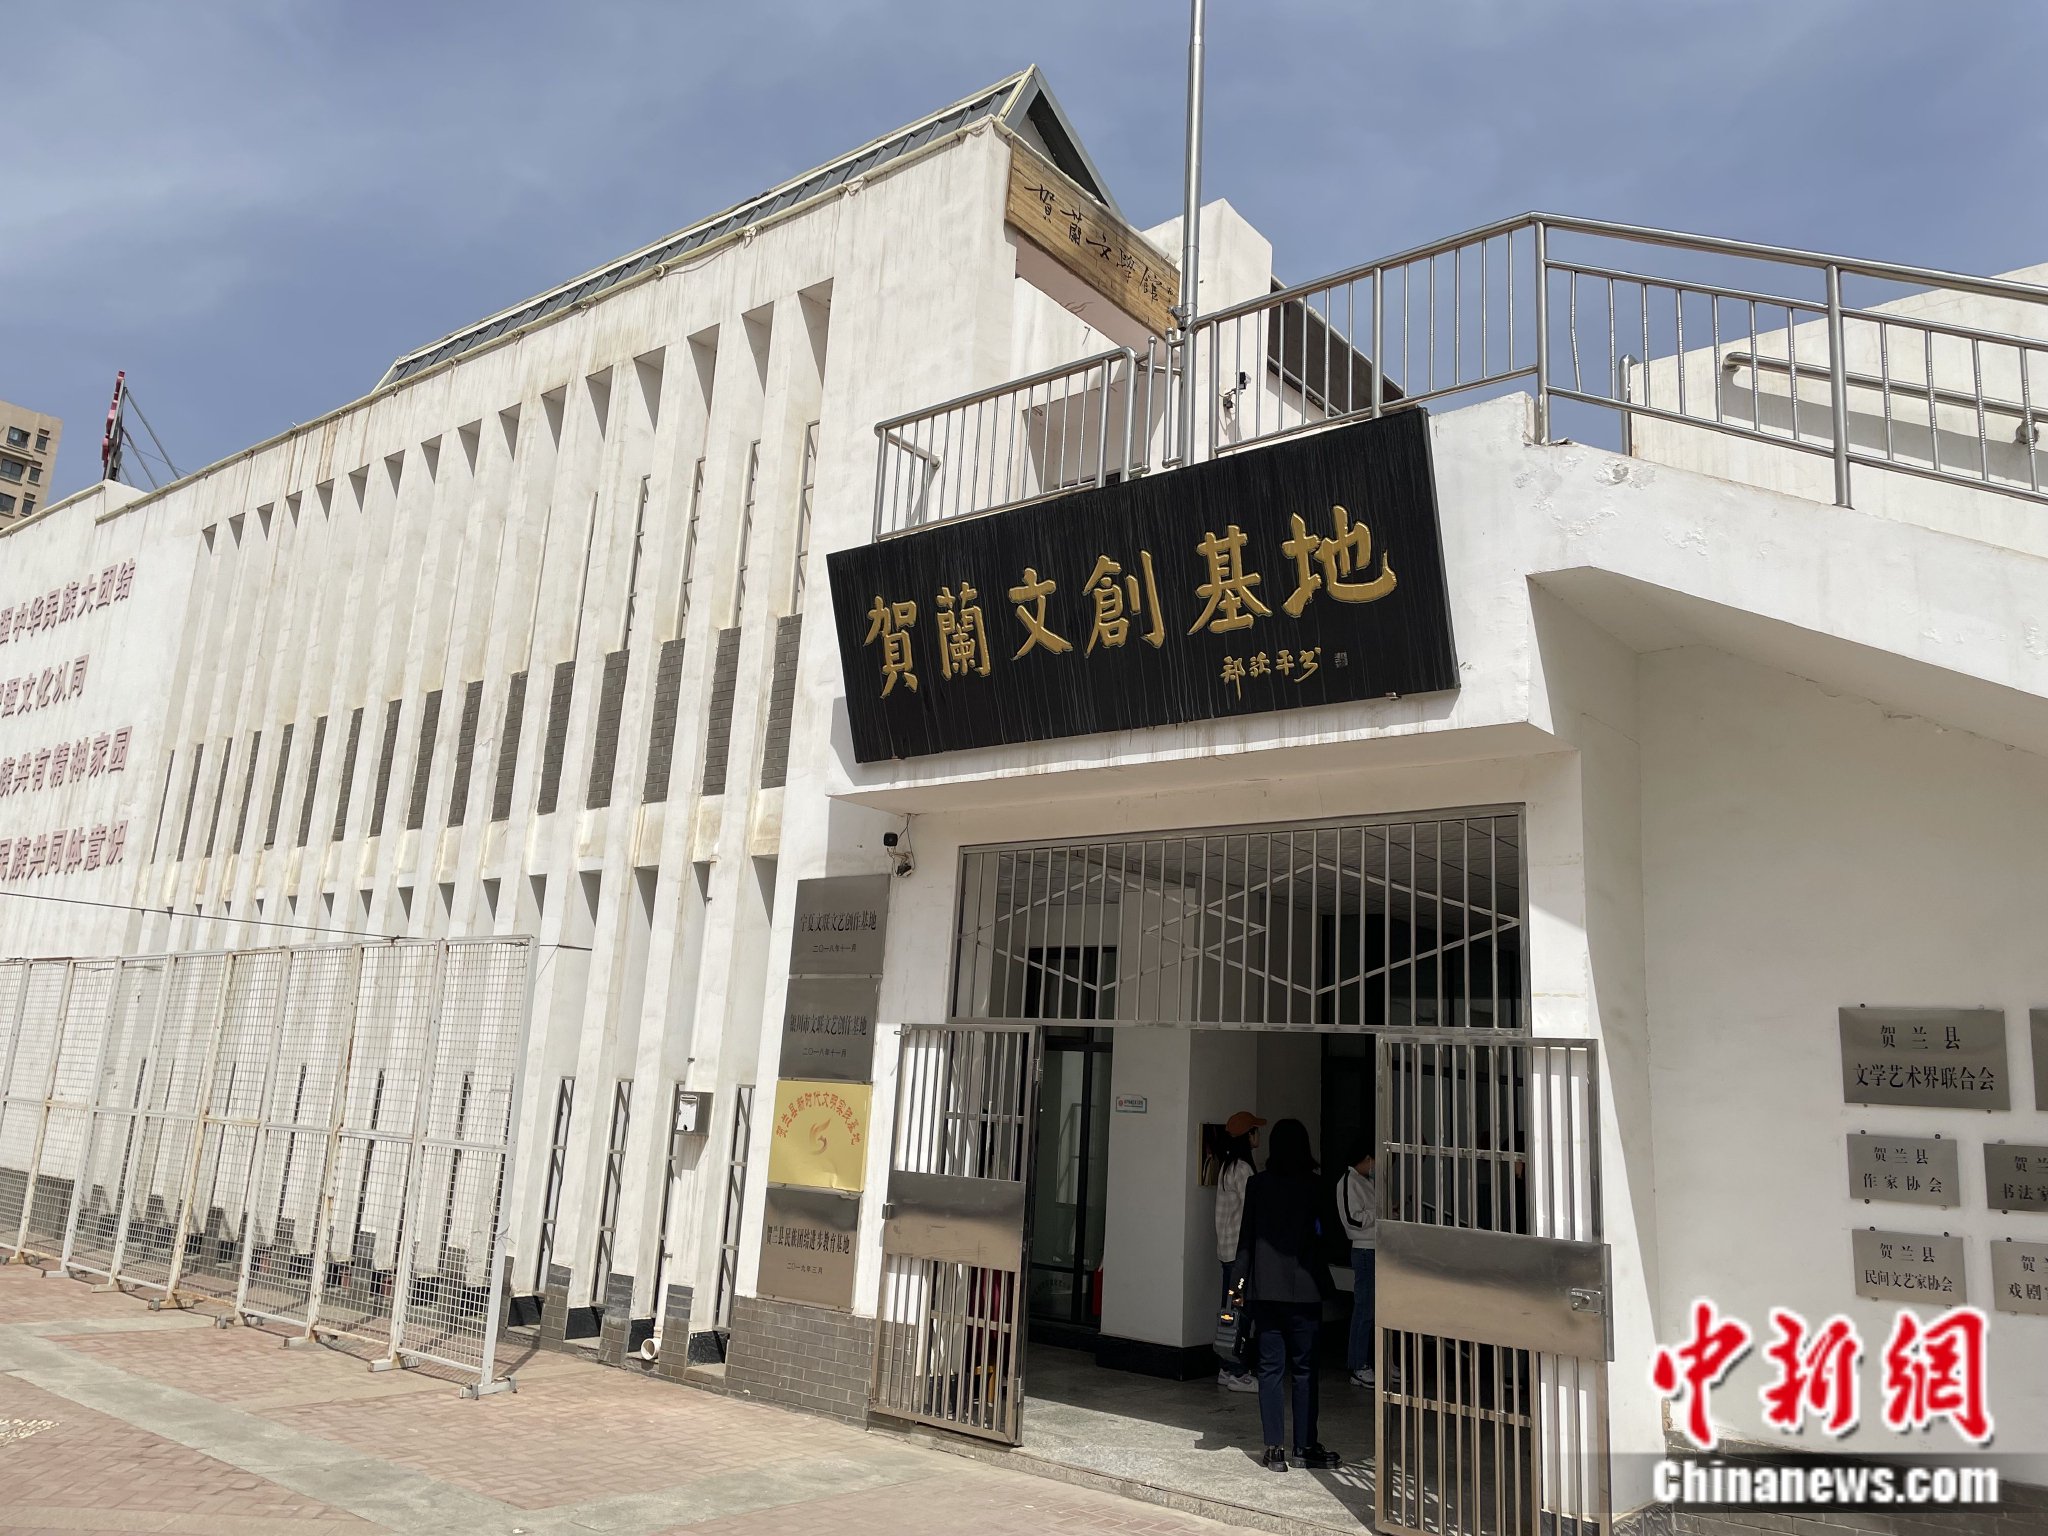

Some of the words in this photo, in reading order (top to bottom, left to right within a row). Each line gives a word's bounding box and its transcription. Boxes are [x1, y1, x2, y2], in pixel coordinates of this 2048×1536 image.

[863, 504, 1398, 699] 賀蘭文創基地
[800, 910, 877, 933] 宁夏文联文艺创作基地
[1880, 1024, 1961, 1050] 贺兰县
[1854, 1063, 1995, 1092] 文学艺术界联合会
[1874, 1146, 1929, 1165] 贺兰县
[1863, 1173, 1943, 1193] 作家协会
[1880, 1242, 1936, 1263] 贺兰县
[1865, 1269, 1953, 1293] 民间文艺家协会
[2008, 1282, 2048, 1300] 戏剧
